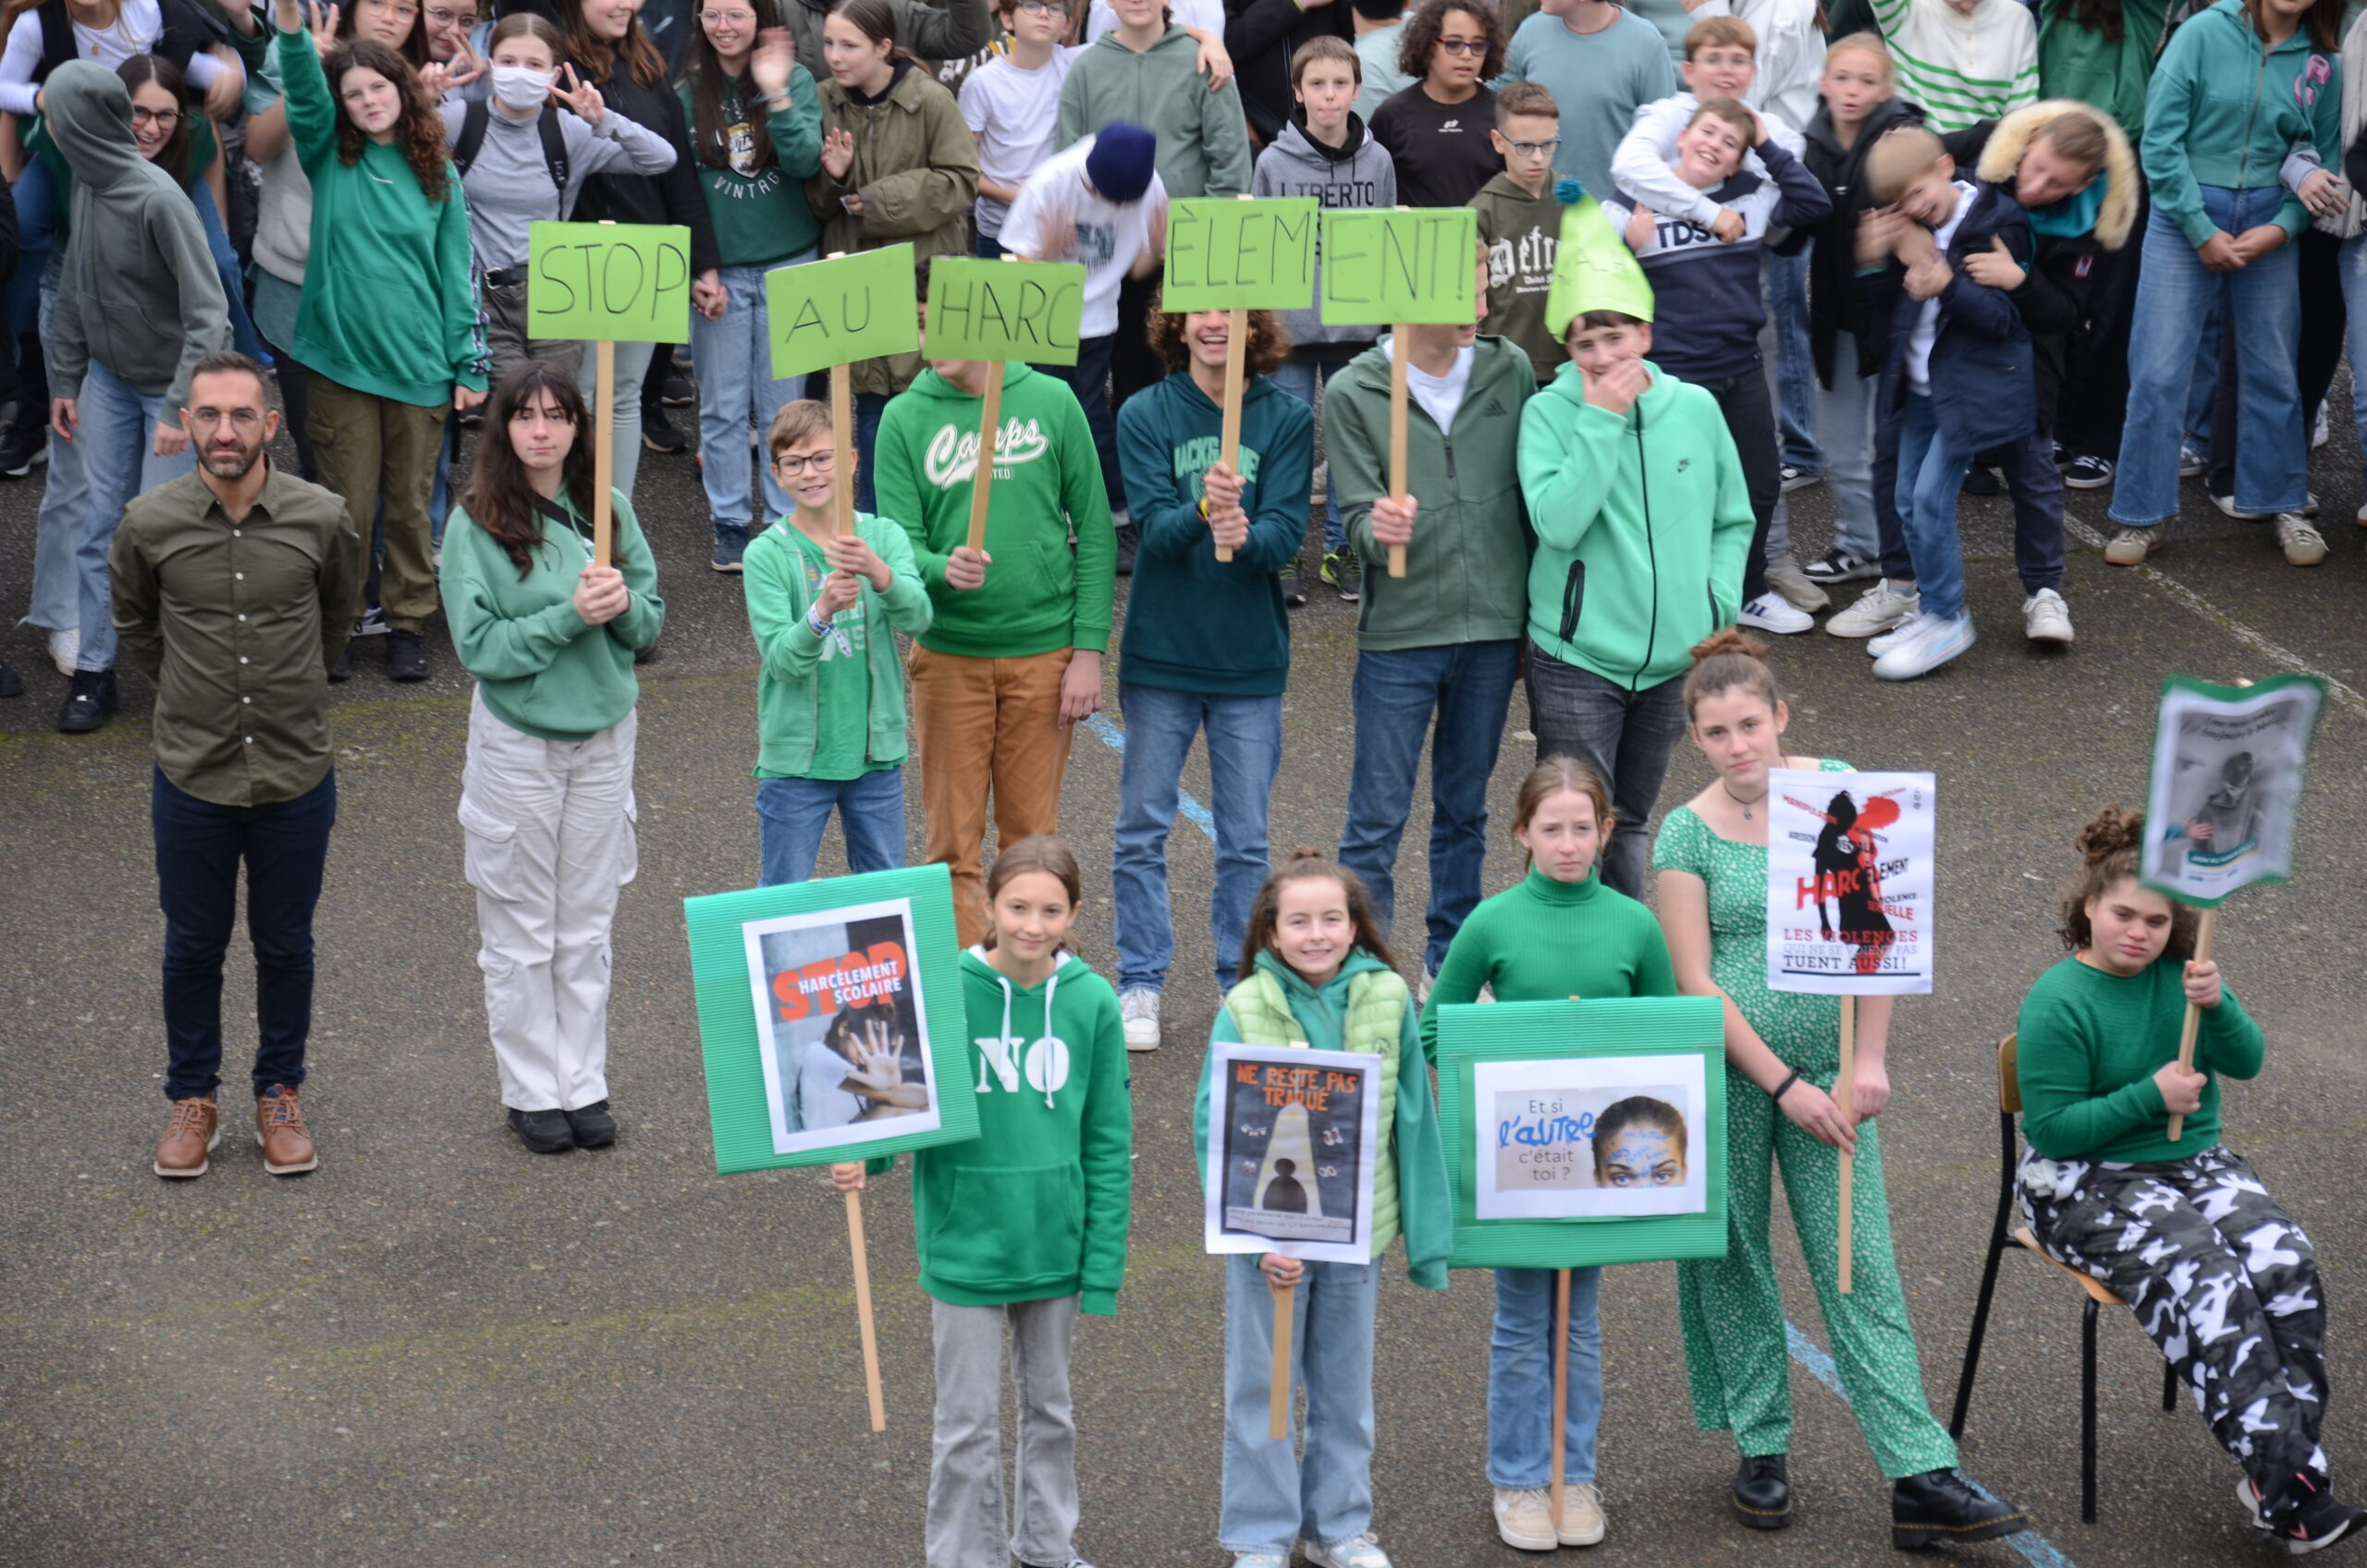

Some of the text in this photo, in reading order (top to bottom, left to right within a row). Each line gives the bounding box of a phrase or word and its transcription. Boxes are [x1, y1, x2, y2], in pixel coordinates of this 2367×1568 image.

[713, 165, 783, 200] VINTAG
[536, 242, 688, 322] STOP
[785, 285, 871, 344] AU
[938, 279, 1079, 350] HARC
[1783, 928, 1919, 944] LES VIOLENCES
[1783, 943, 1918, 956] QUI NE SE VOIENT PAS
[1783, 955, 1842, 969] TUENT
[773, 940, 907, 1023] STOP
[799, 961, 898, 996] HARCÈLEMENT
[834, 977, 902, 1005] SCOLAIRE
[974, 1036, 1070, 1093] NO
[1236, 1063, 1359, 1095] NE RESTE PAS
[1528, 1097, 1563, 1114] Et si
[1518, 1149, 1575, 1165] c'était
[1532, 1167, 1571, 1182] toi ?
